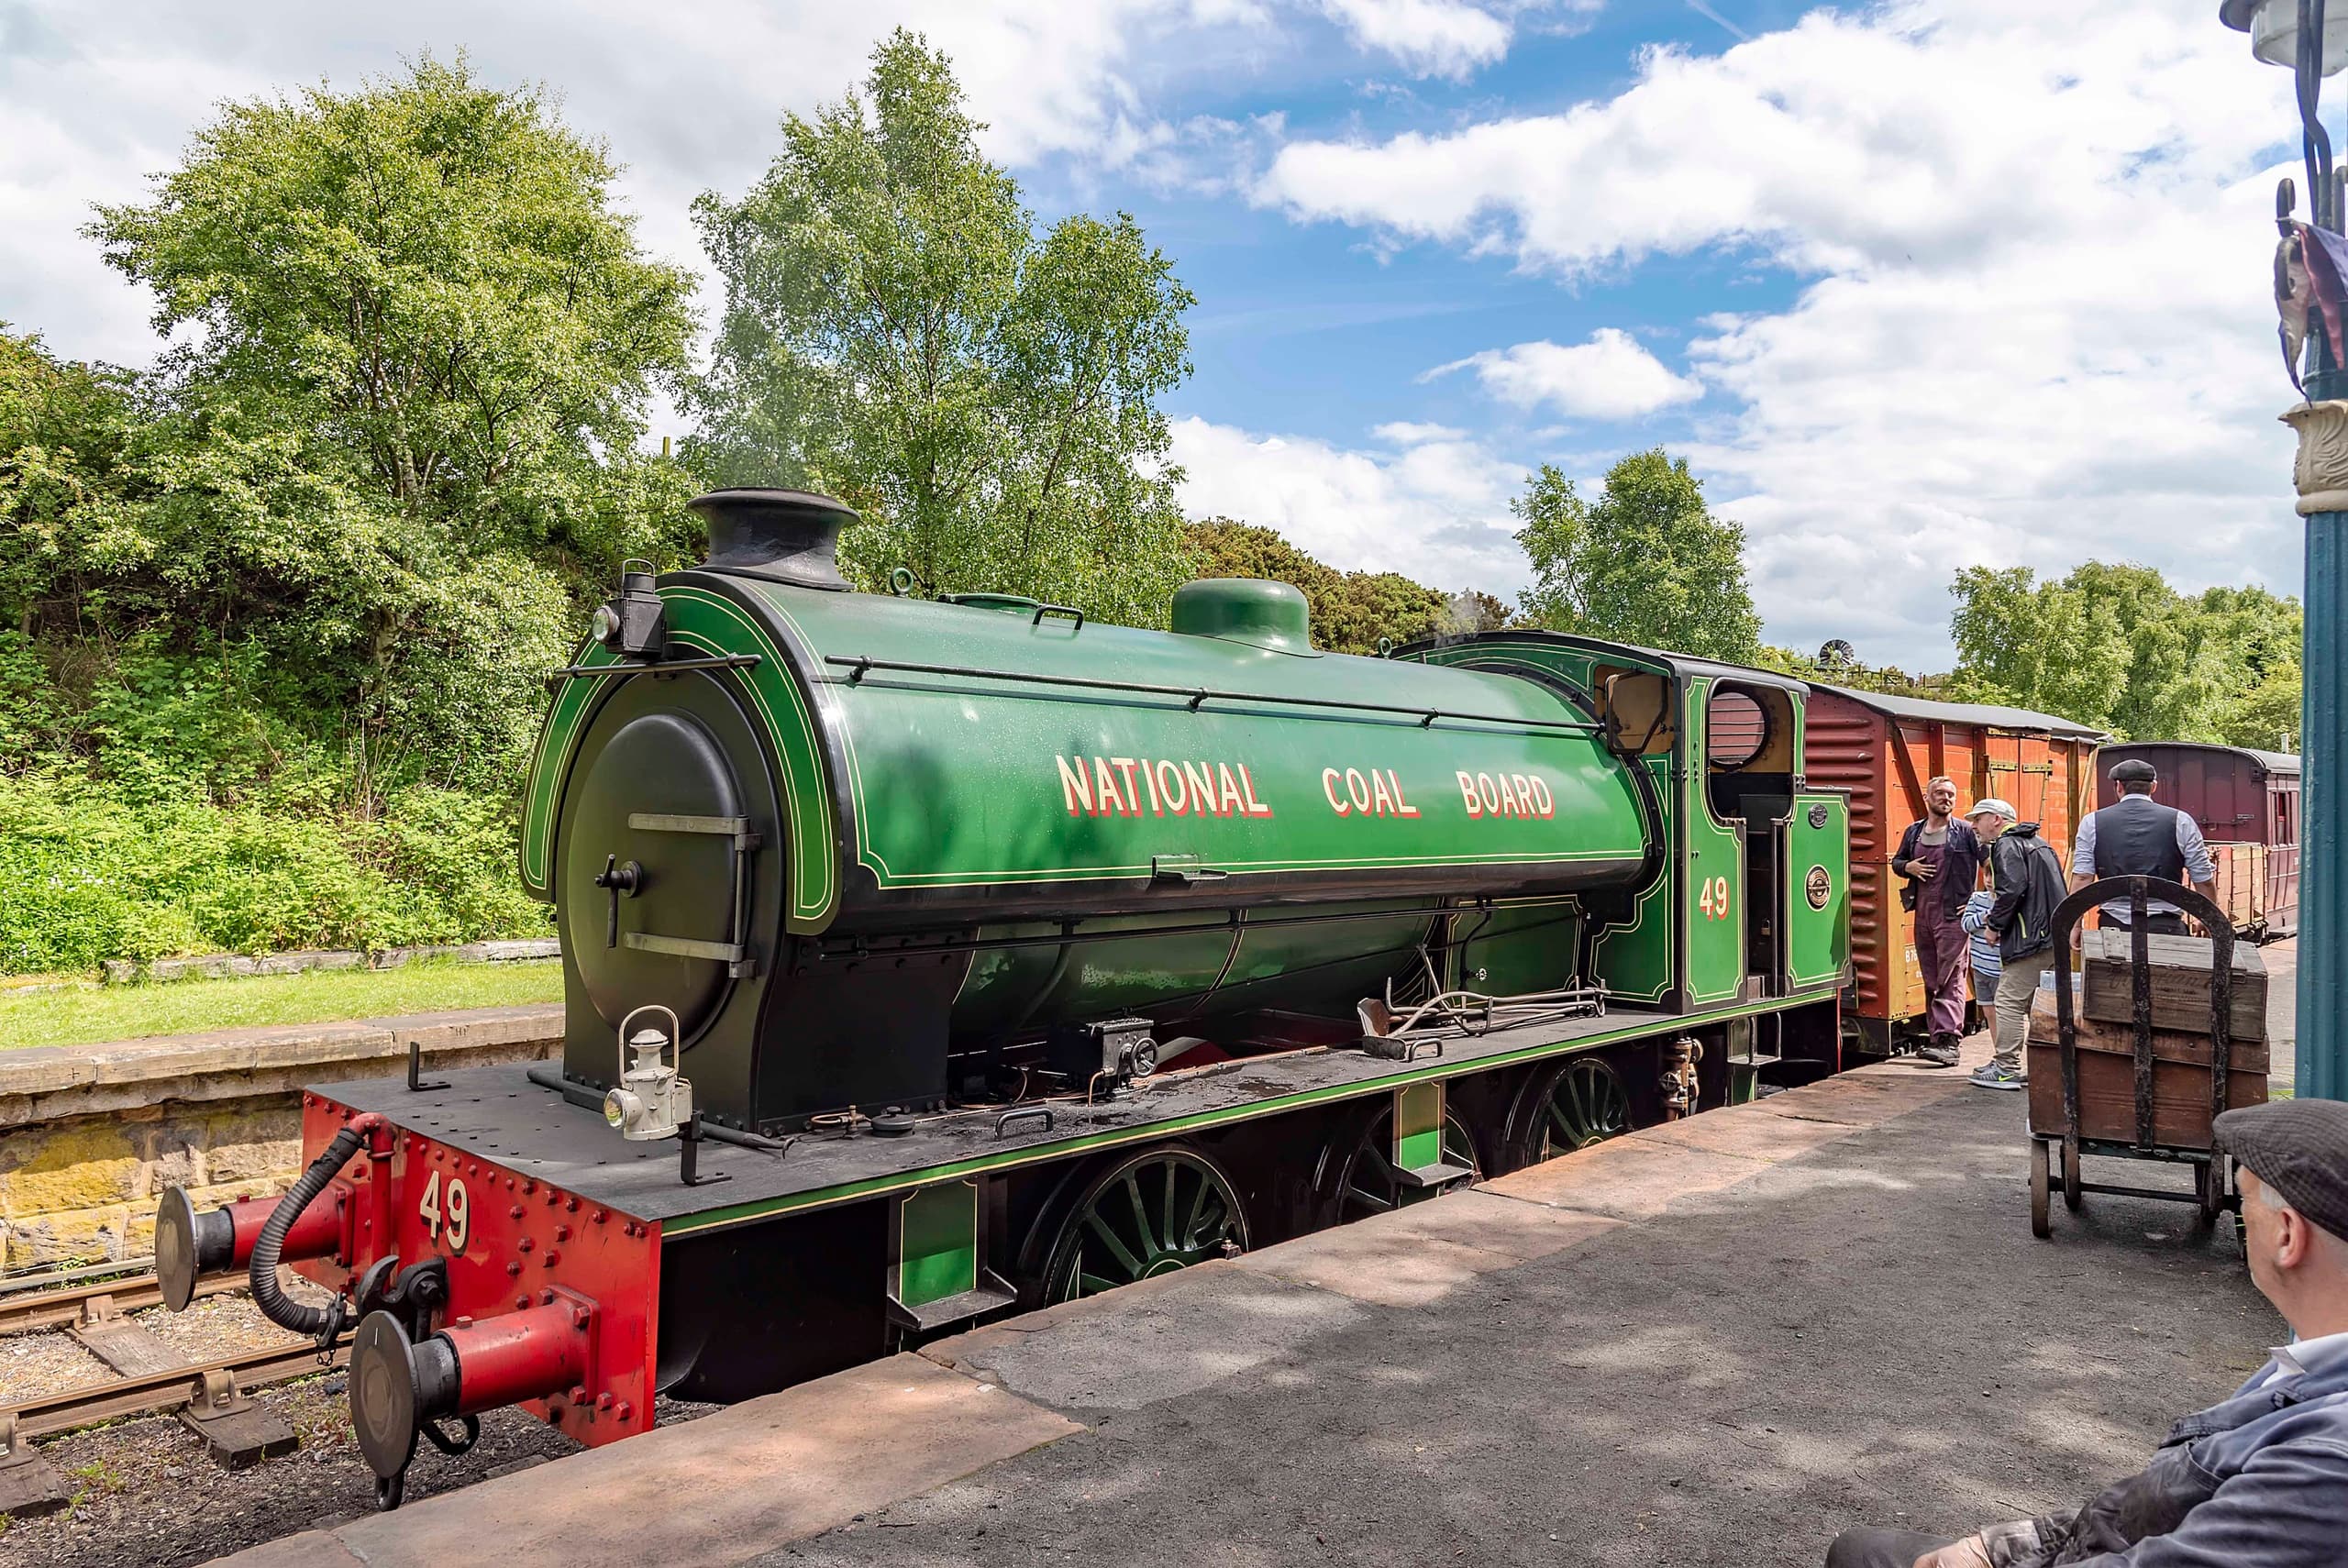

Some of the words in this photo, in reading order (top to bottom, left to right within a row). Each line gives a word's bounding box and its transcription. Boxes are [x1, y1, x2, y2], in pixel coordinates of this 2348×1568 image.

[1057, 755, 1272, 817] NATIONAL
[1322, 767, 1421, 818] COAL
[1456, 770, 1555, 819] BOARD
[1700, 877, 1730, 921] 49
[420, 1170, 469, 1254] 49
